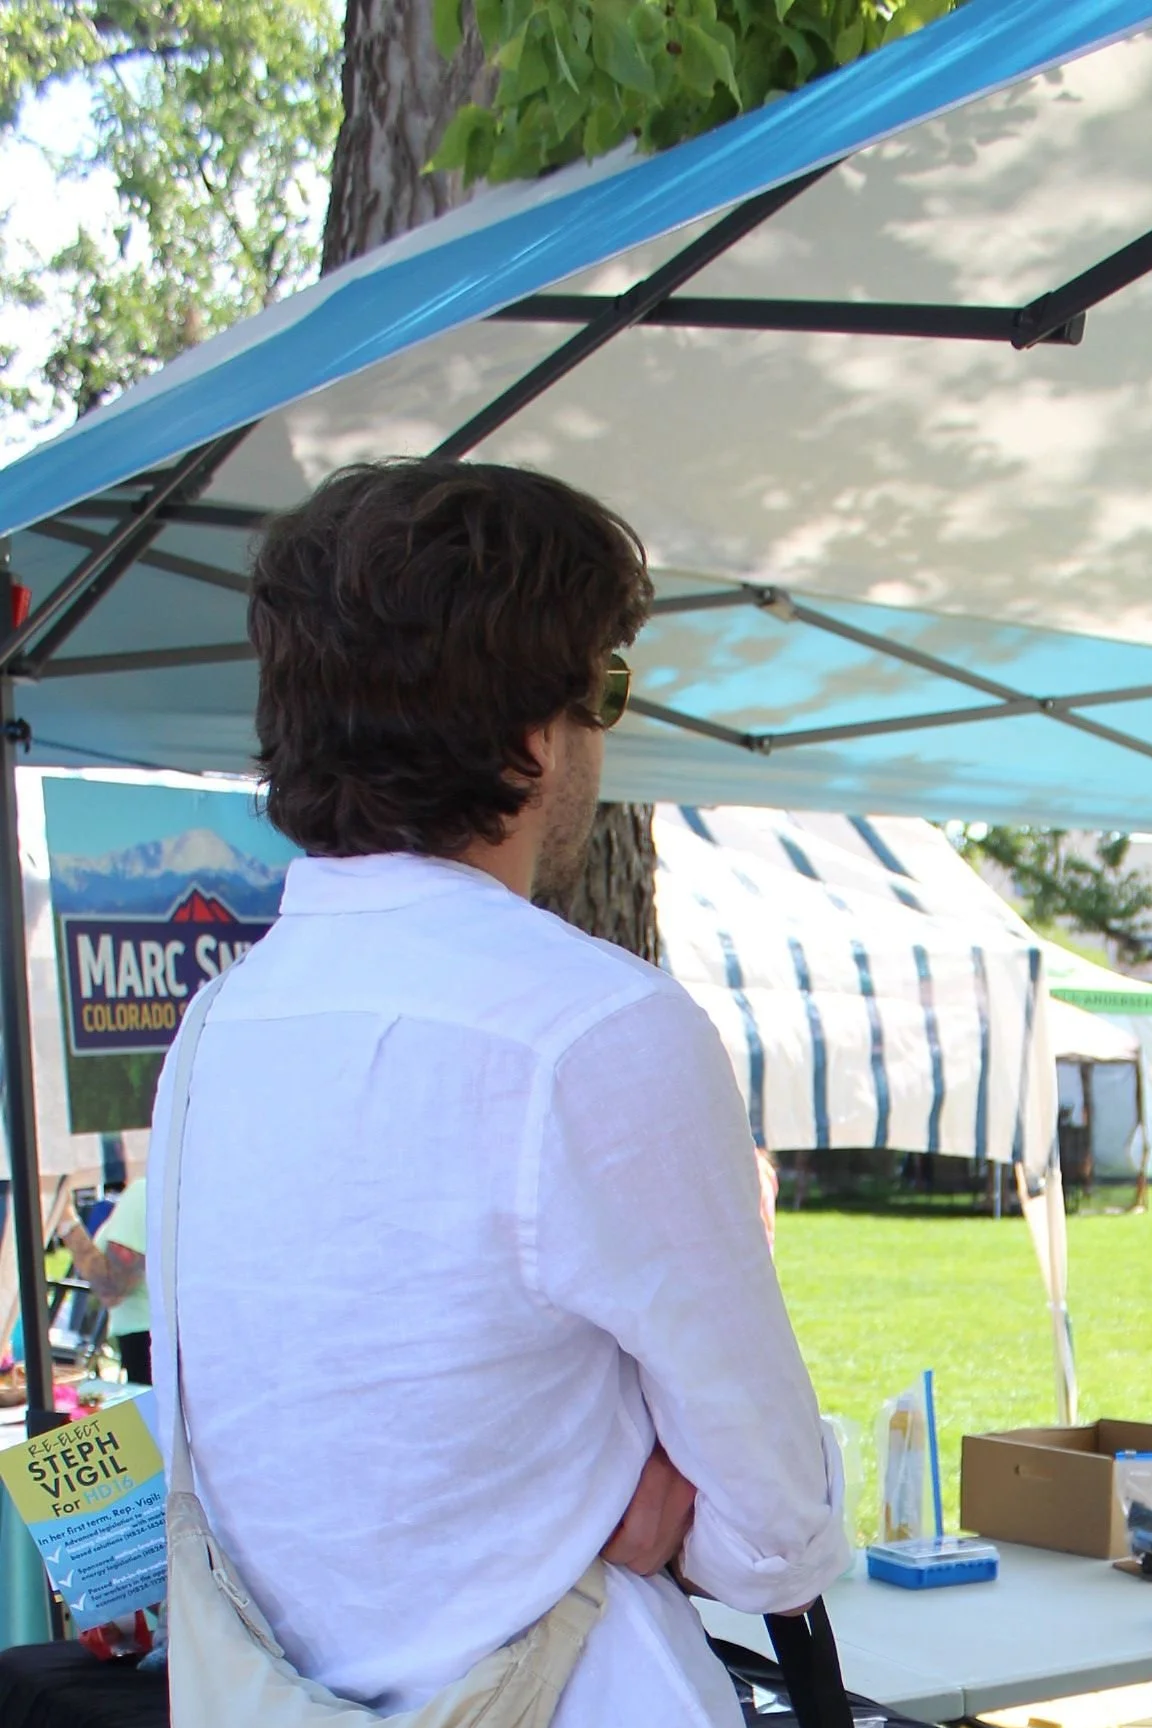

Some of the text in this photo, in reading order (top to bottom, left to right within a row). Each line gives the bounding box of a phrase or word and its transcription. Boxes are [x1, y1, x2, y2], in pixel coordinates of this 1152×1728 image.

[76, 933, 188, 999] MARC
[82, 1002, 176, 1033] COLORADO
[28, 1420, 101, 1458] RE-ELECT
[28, 1431, 120, 1481] STEPH
[40, 1455, 128, 1499] VIGIL
[38, 1538, 48, 1546] In
[50, 1530, 66, 1542] her
[67, 1524, 86, 1536] first
[87, 1514, 112, 1528] term,
[112, 1506, 135, 1520] Rep.
[135, 1493, 161, 1509] Vigil:
[52, 1499, 81, 1518] For
